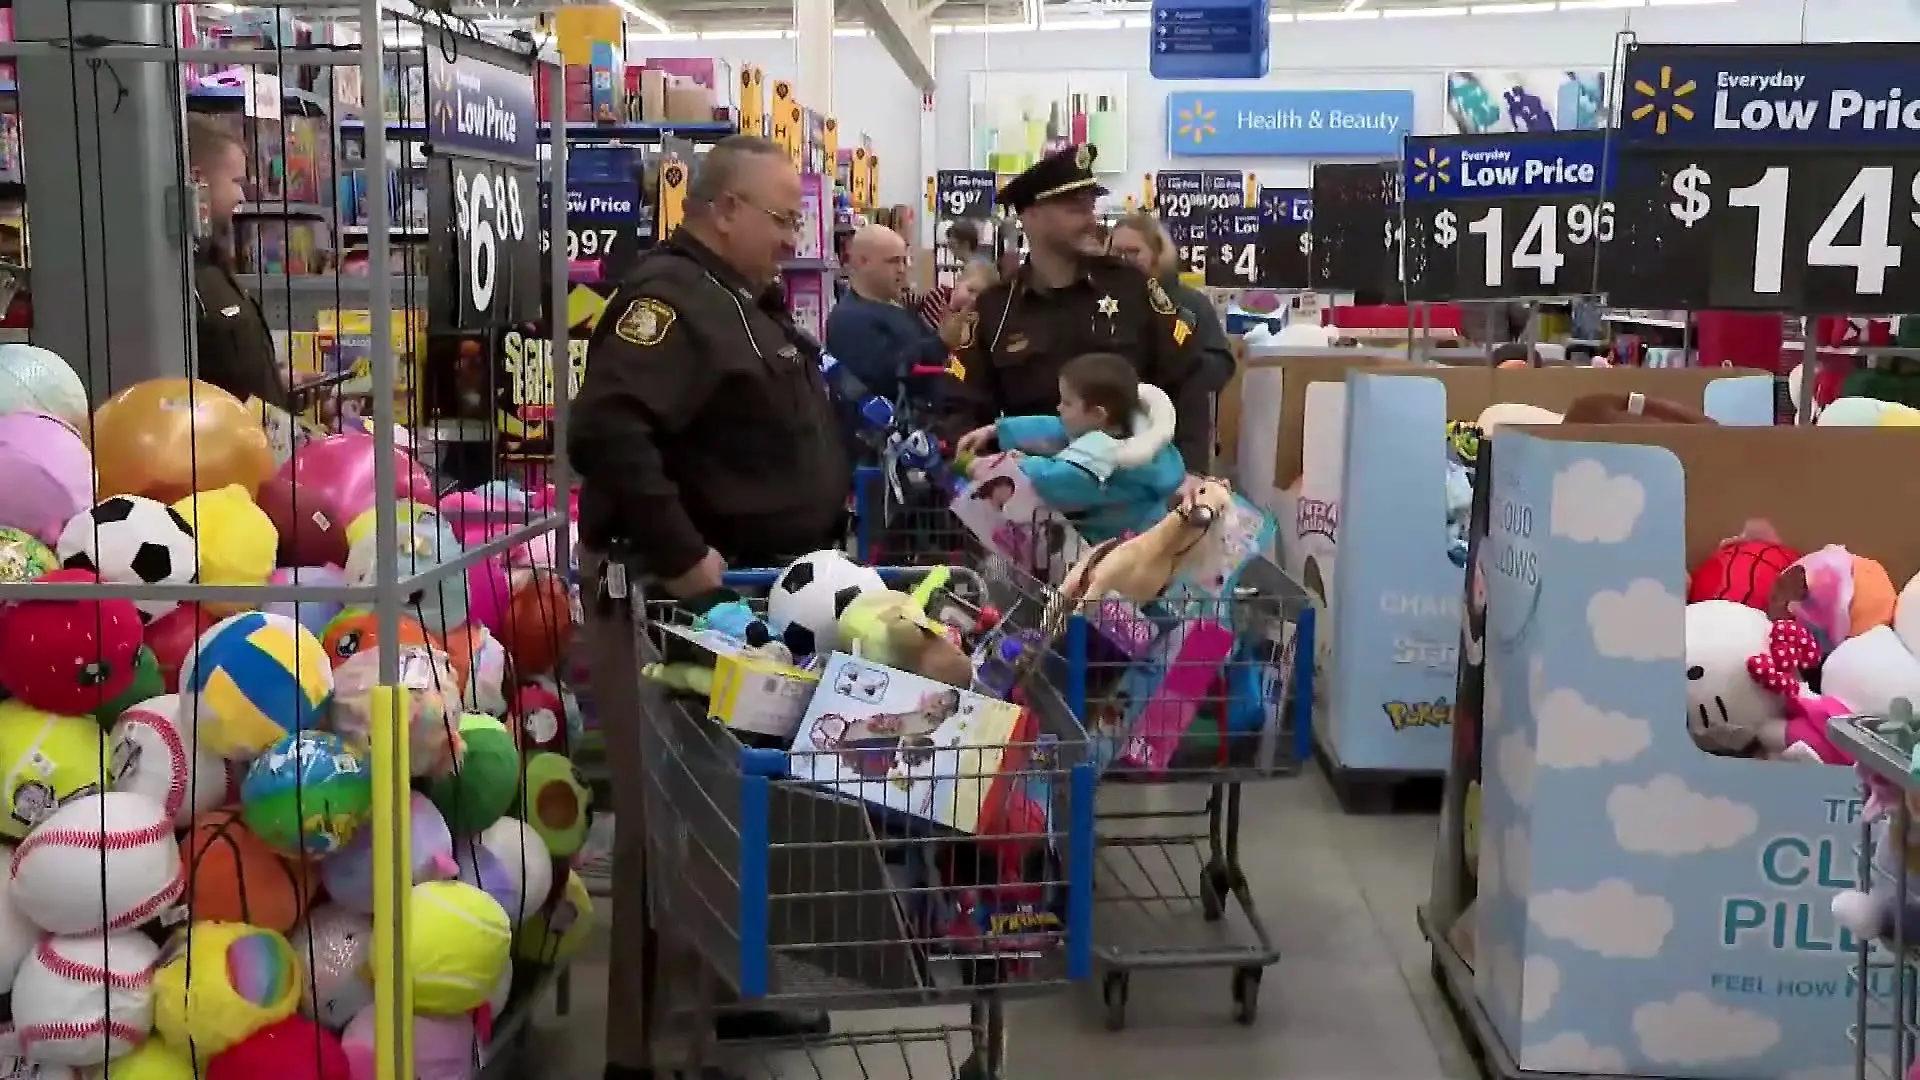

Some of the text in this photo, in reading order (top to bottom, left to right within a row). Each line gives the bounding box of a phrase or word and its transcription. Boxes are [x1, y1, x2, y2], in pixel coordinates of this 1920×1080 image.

[1717, 71, 1806, 91] Everyday
[457, 88, 516, 143] Low Price
[1237, 108, 1399, 135] Health & Beauty
[1714, 90, 1823, 131] Low
[1461, 148, 1511, 163] Everyday
[1461, 156, 1595, 187] Low Price
[566, 196, 631, 213] ow Price
[1711, 973, 1768, 994] FEEL
[1777, 979, 1838, 998] HOW
